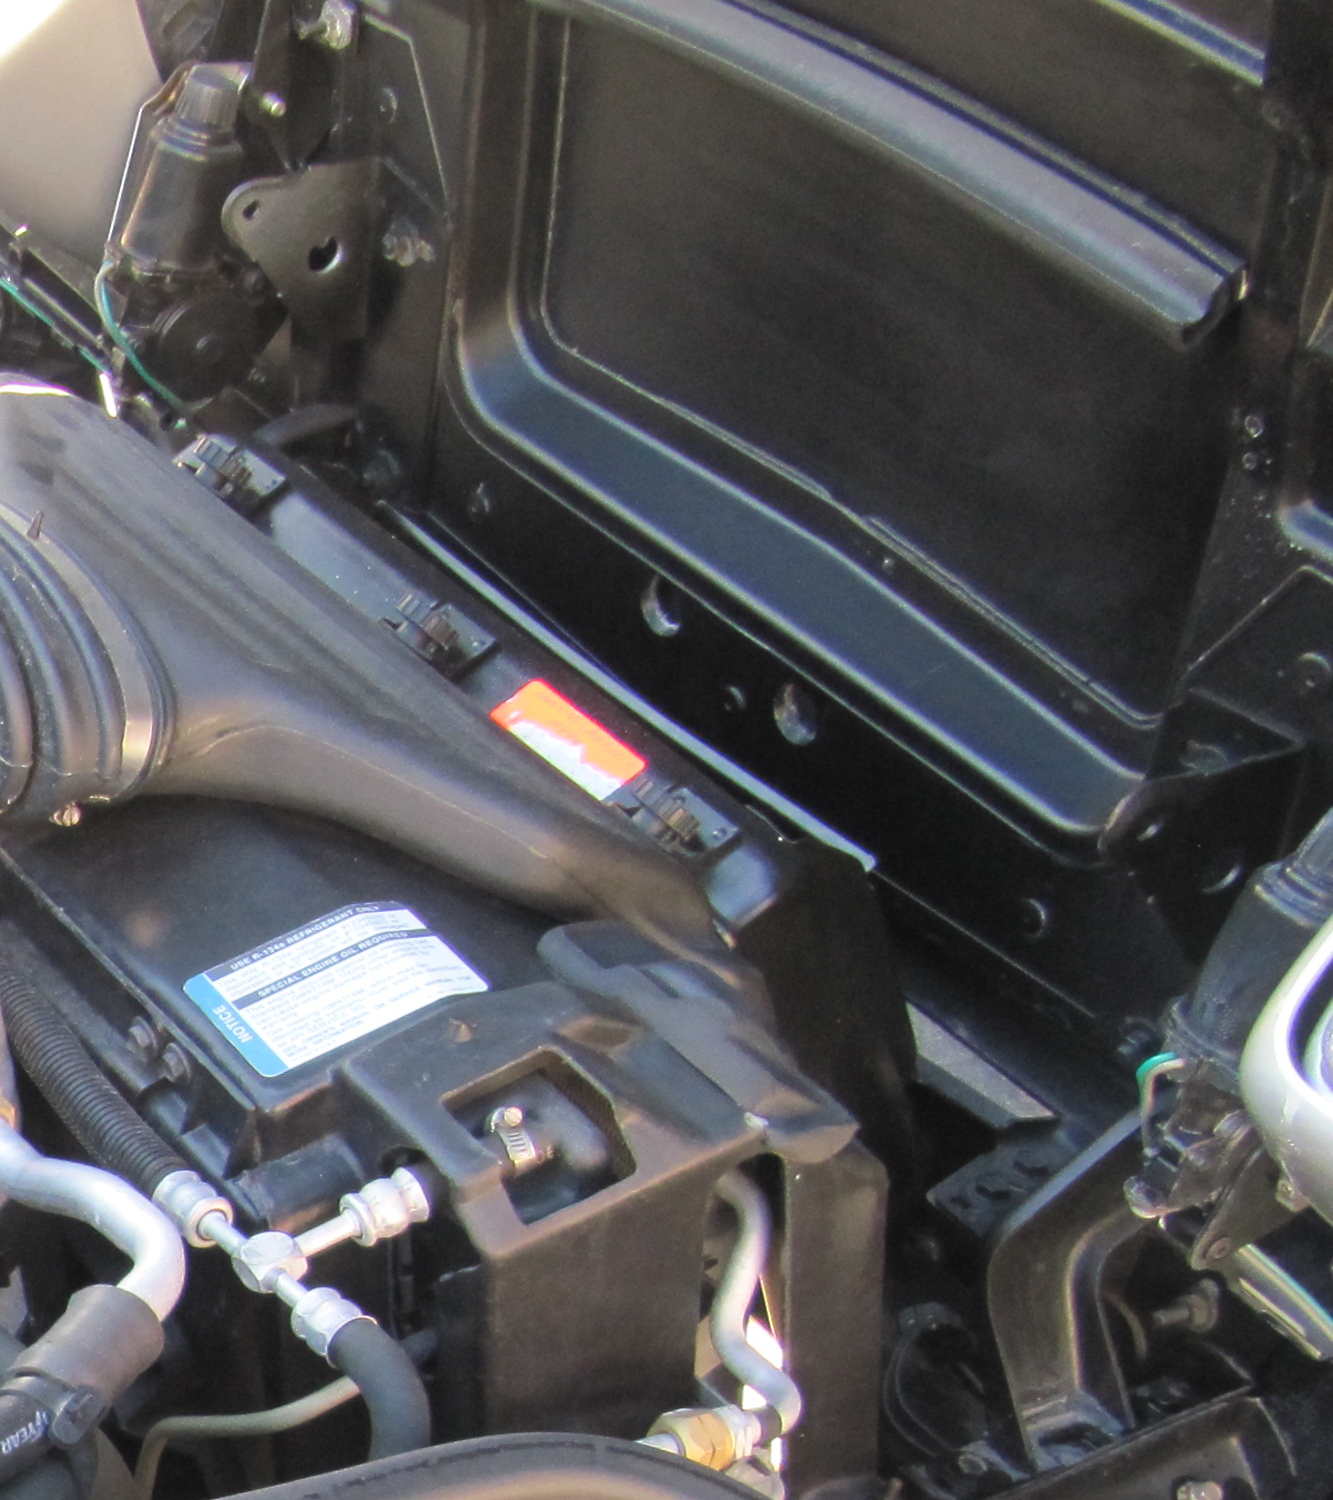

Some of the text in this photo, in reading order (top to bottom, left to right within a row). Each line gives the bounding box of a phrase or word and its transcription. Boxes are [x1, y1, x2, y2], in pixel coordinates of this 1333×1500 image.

[230, 956, 251, 970] USE
[250, 940, 285, 961] R-134a
[285, 906, 354, 946] REFRIGERANT
[256, 930, 409, 997] SPECIAL ENGINE OIL REQUIRED
[211, 1004, 254, 1045] NOTICE
